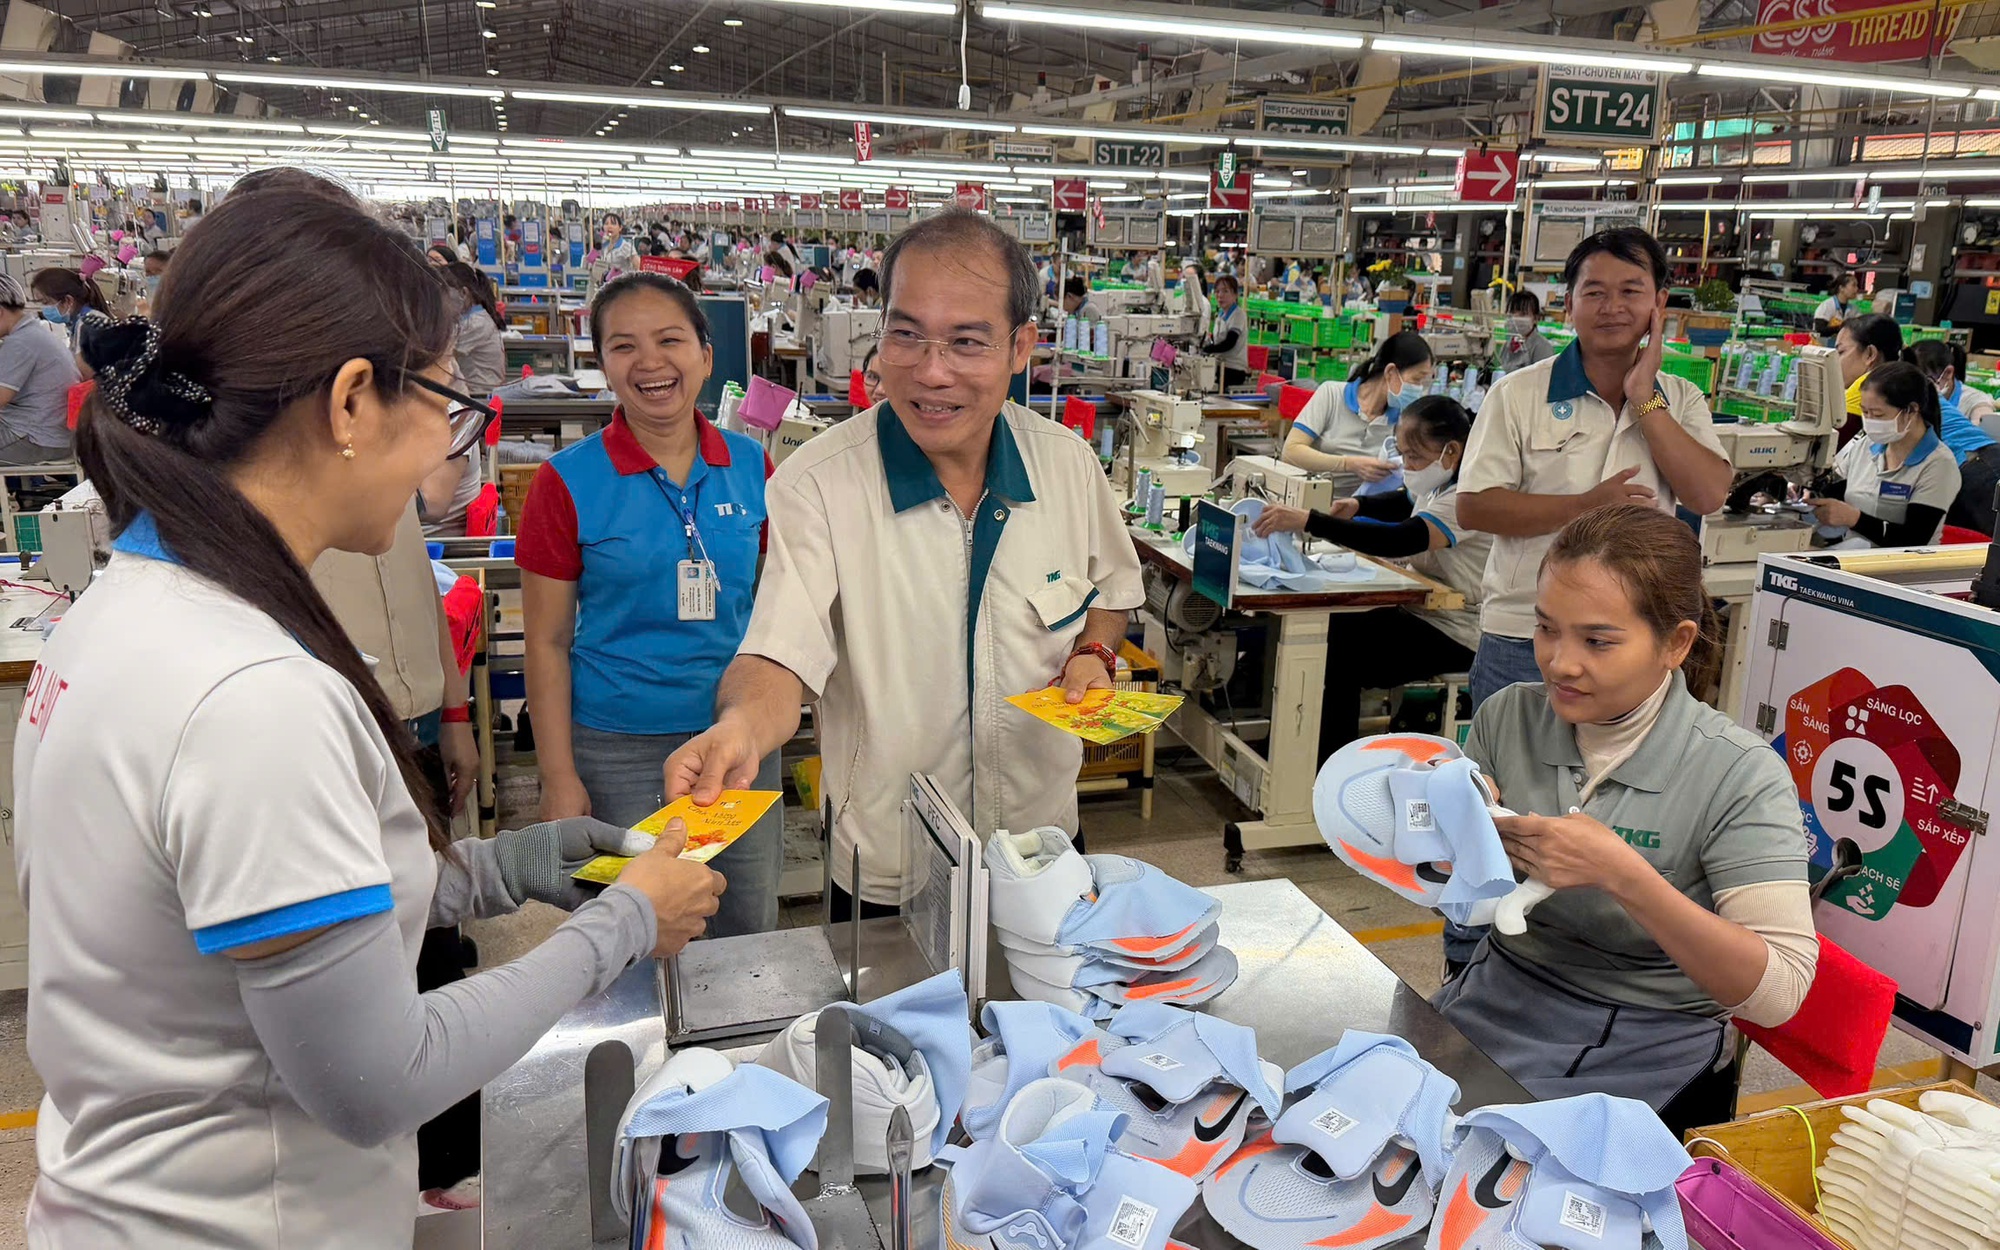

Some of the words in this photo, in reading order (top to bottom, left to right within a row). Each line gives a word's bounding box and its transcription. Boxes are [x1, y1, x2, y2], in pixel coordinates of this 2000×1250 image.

[1849, 9, 1929, 47] THREAD
[1550, 87, 1650, 128] STT-24
[1098, 144, 1161, 167] STT-22
[1750, 446, 1777, 454] JUKI
[1769, 571, 1798, 591] TKG
[1800, 586, 1837, 603] TAEKWANG
[1837, 597, 1855, 608] VINA
[1802, 715, 1830, 734] SÀNG
[1866, 697, 1897, 717] SÀNG
[1898, 709, 1922, 726] LỌC
[1827, 759, 1891, 829] 5S
[1917, 817, 1940, 836] SẮP
[1941, 827, 1966, 846] XẾP
[1859, 866, 1885, 884] ẠCH
